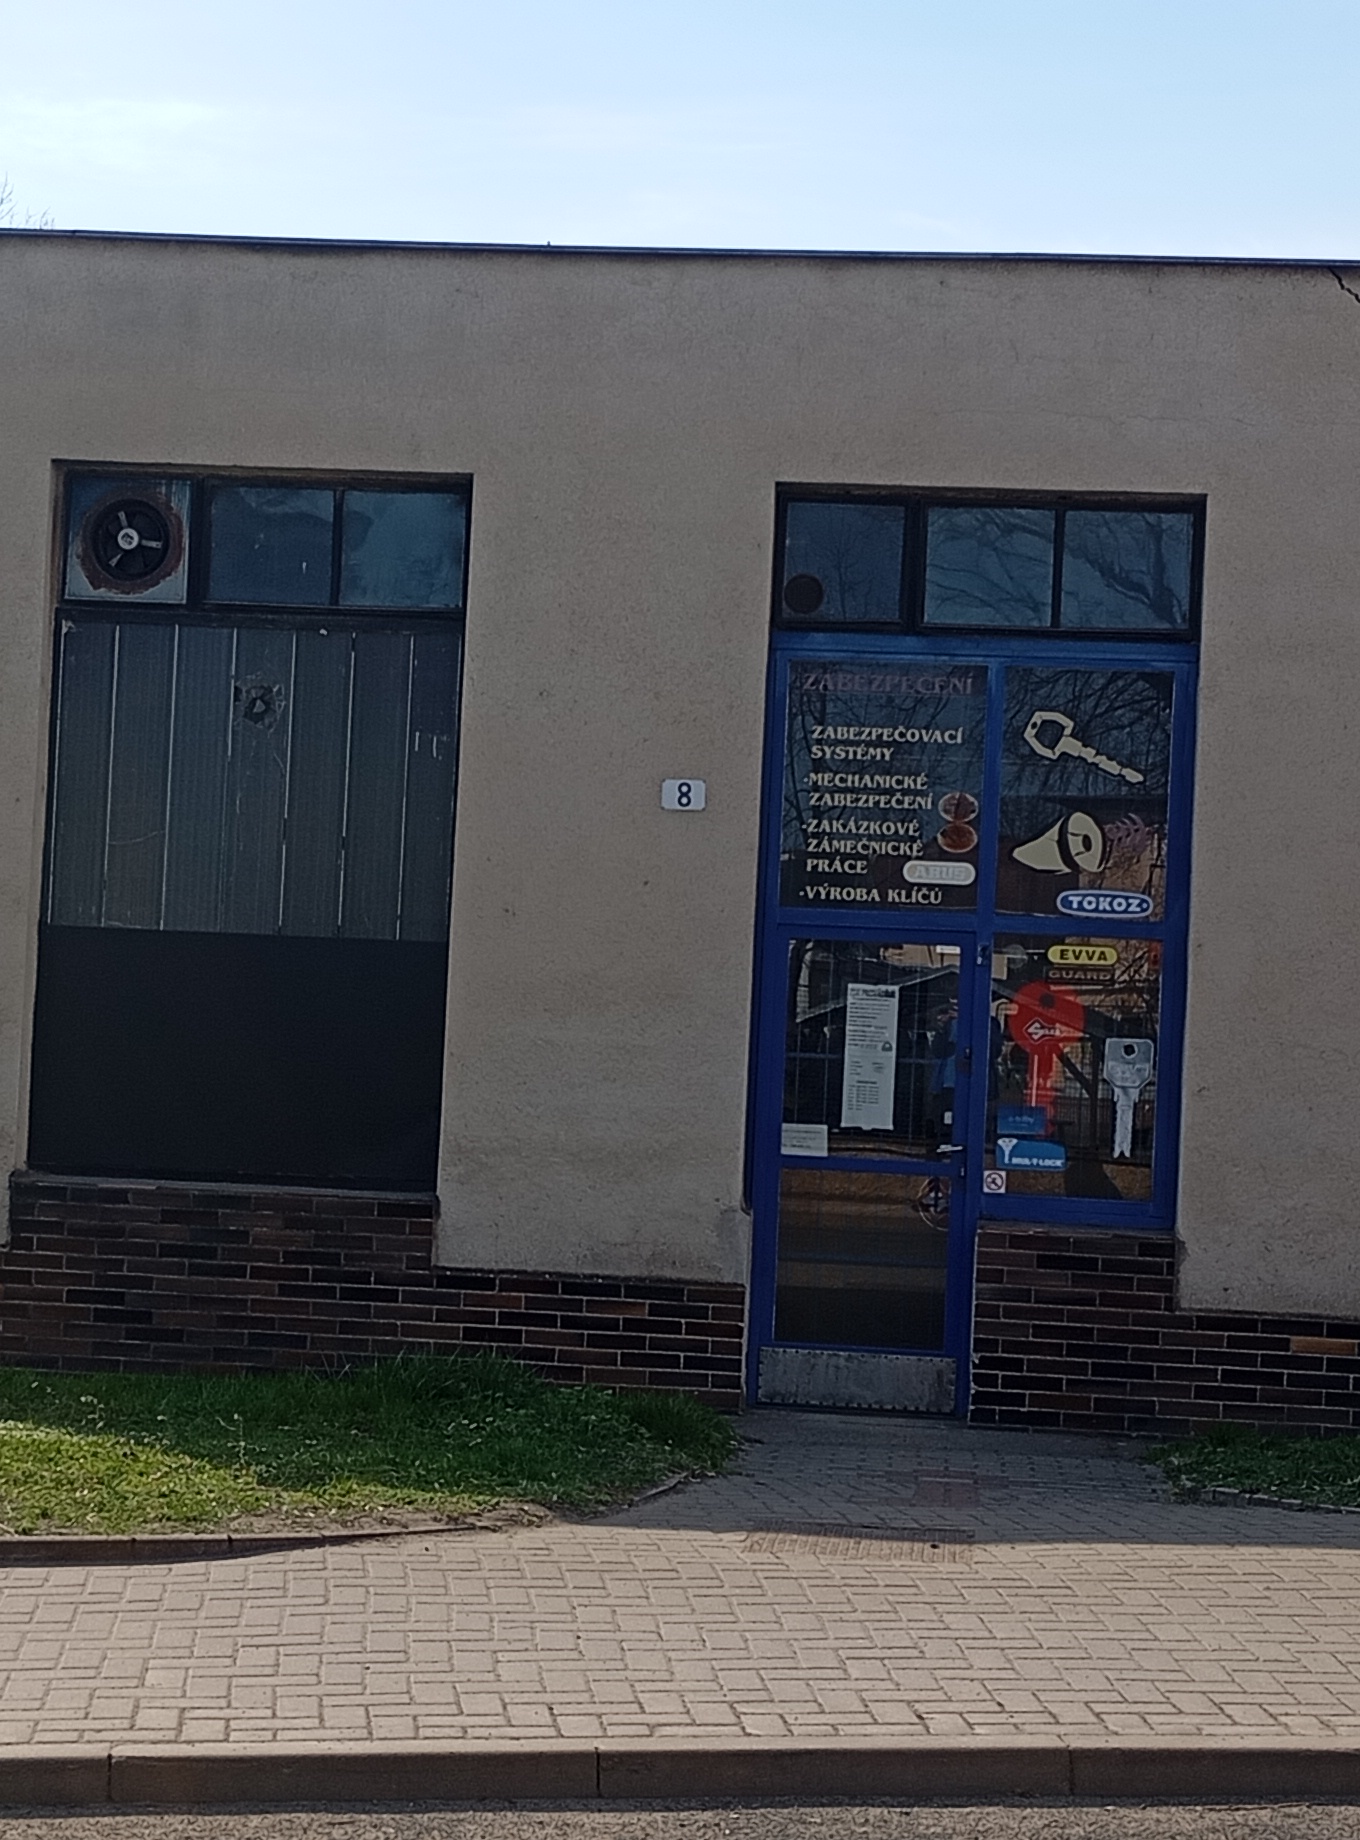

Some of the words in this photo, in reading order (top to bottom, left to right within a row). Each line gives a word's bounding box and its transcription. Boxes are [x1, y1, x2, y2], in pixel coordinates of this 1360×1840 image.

[802, 672, 974, 695] ZABEZPEČENÍ
[811, 725, 964, 744] ZABEZPEČOVACÍ
[810, 744, 894, 762] SYSTÉMY
[677, 782, 691, 807] 8
[808, 792, 934, 810] ZABEZPEČENÍ
[806, 837, 924, 856] ZÁMEČNICKÉ
[806, 856, 869, 874] PRÁCE
[914, 865, 967, 880] ABUS
[887, 886, 943, 905] KLÍČŮ
[1067, 896, 1142, 912] TOKOZ
[1059, 949, 1108, 961] EVVA
[1048, 970, 1112, 980] GUARD
